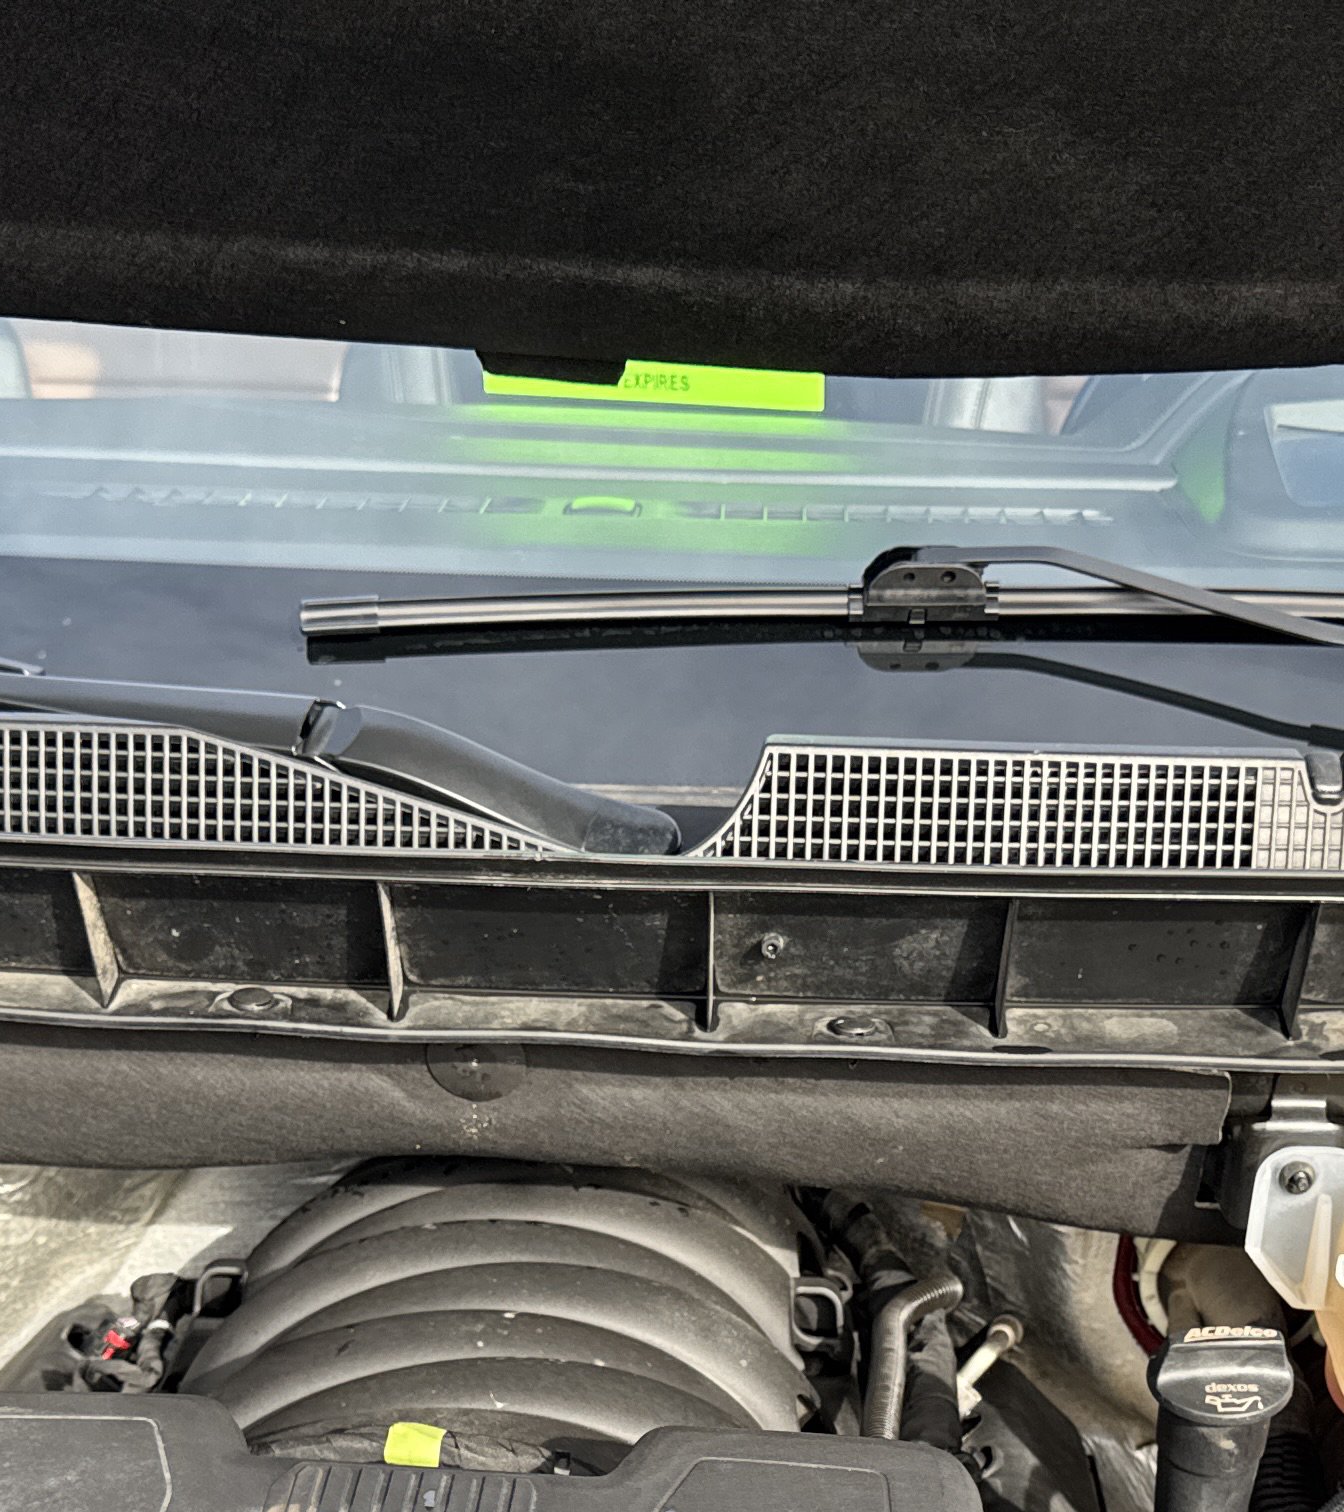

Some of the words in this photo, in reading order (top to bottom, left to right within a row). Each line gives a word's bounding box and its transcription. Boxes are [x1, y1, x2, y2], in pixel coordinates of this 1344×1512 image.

[623, 373, 690, 391] EXPIRES
[1183, 1325, 1278, 1343] ACDelco
[1204, 1382, 1259, 1393] dexos
